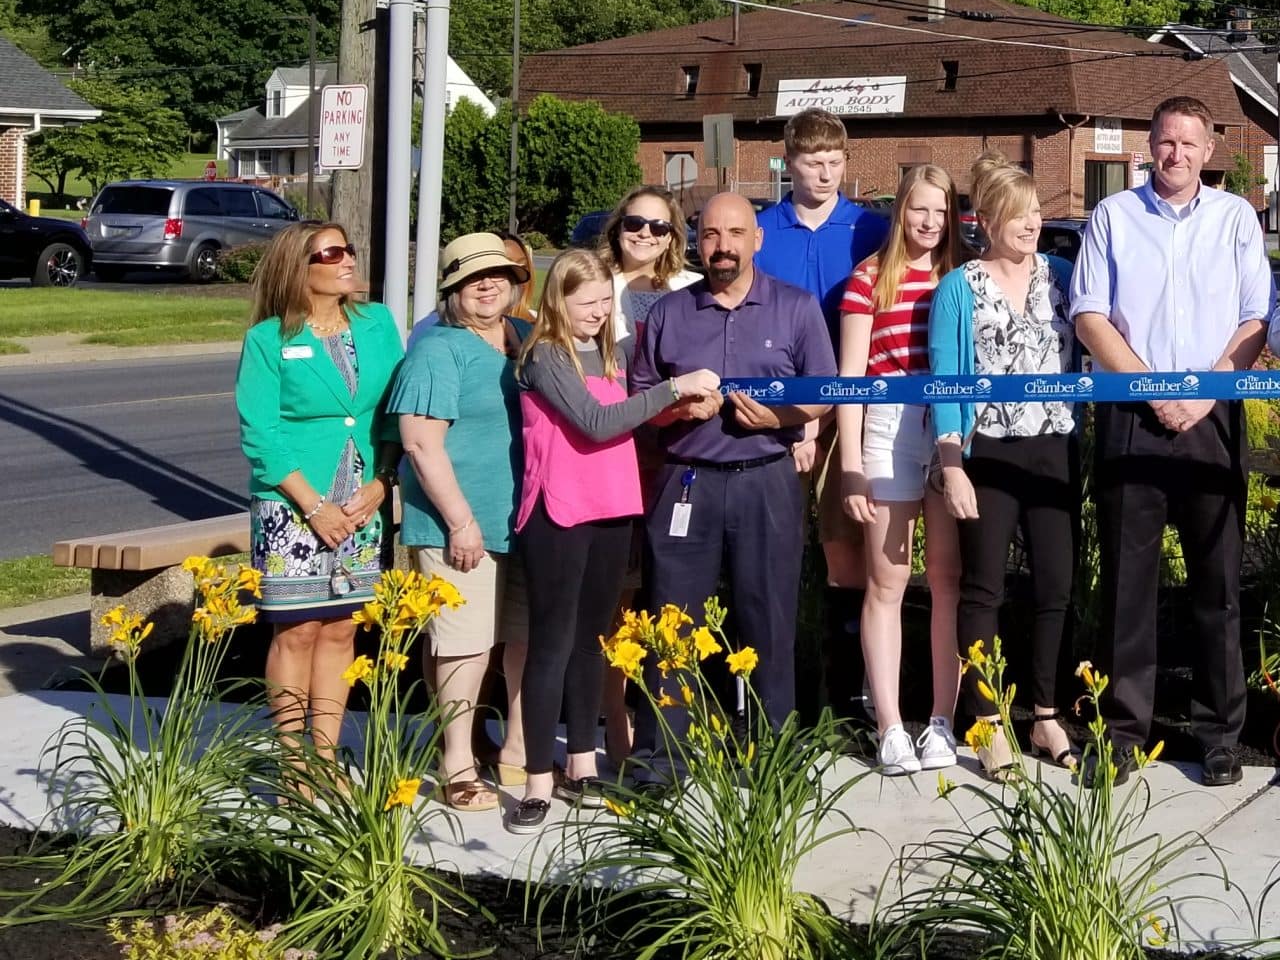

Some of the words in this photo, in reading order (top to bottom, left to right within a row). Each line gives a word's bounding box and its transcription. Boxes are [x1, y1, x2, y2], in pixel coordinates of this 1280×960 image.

[336, 91, 352, 106] NO
[785, 97, 834, 108] AUTO
[845, 95, 896, 106] BODY
[324, 110, 362, 125] PARKING
[334, 131, 350, 143] ANY
[333, 146, 350, 157] TIME
[820, 384, 871, 396] Chamber
[923, 382, 974, 395] Chamber
[1024, 380, 1076, 393] Chamber
[1129, 378, 1181, 392] Chamber
